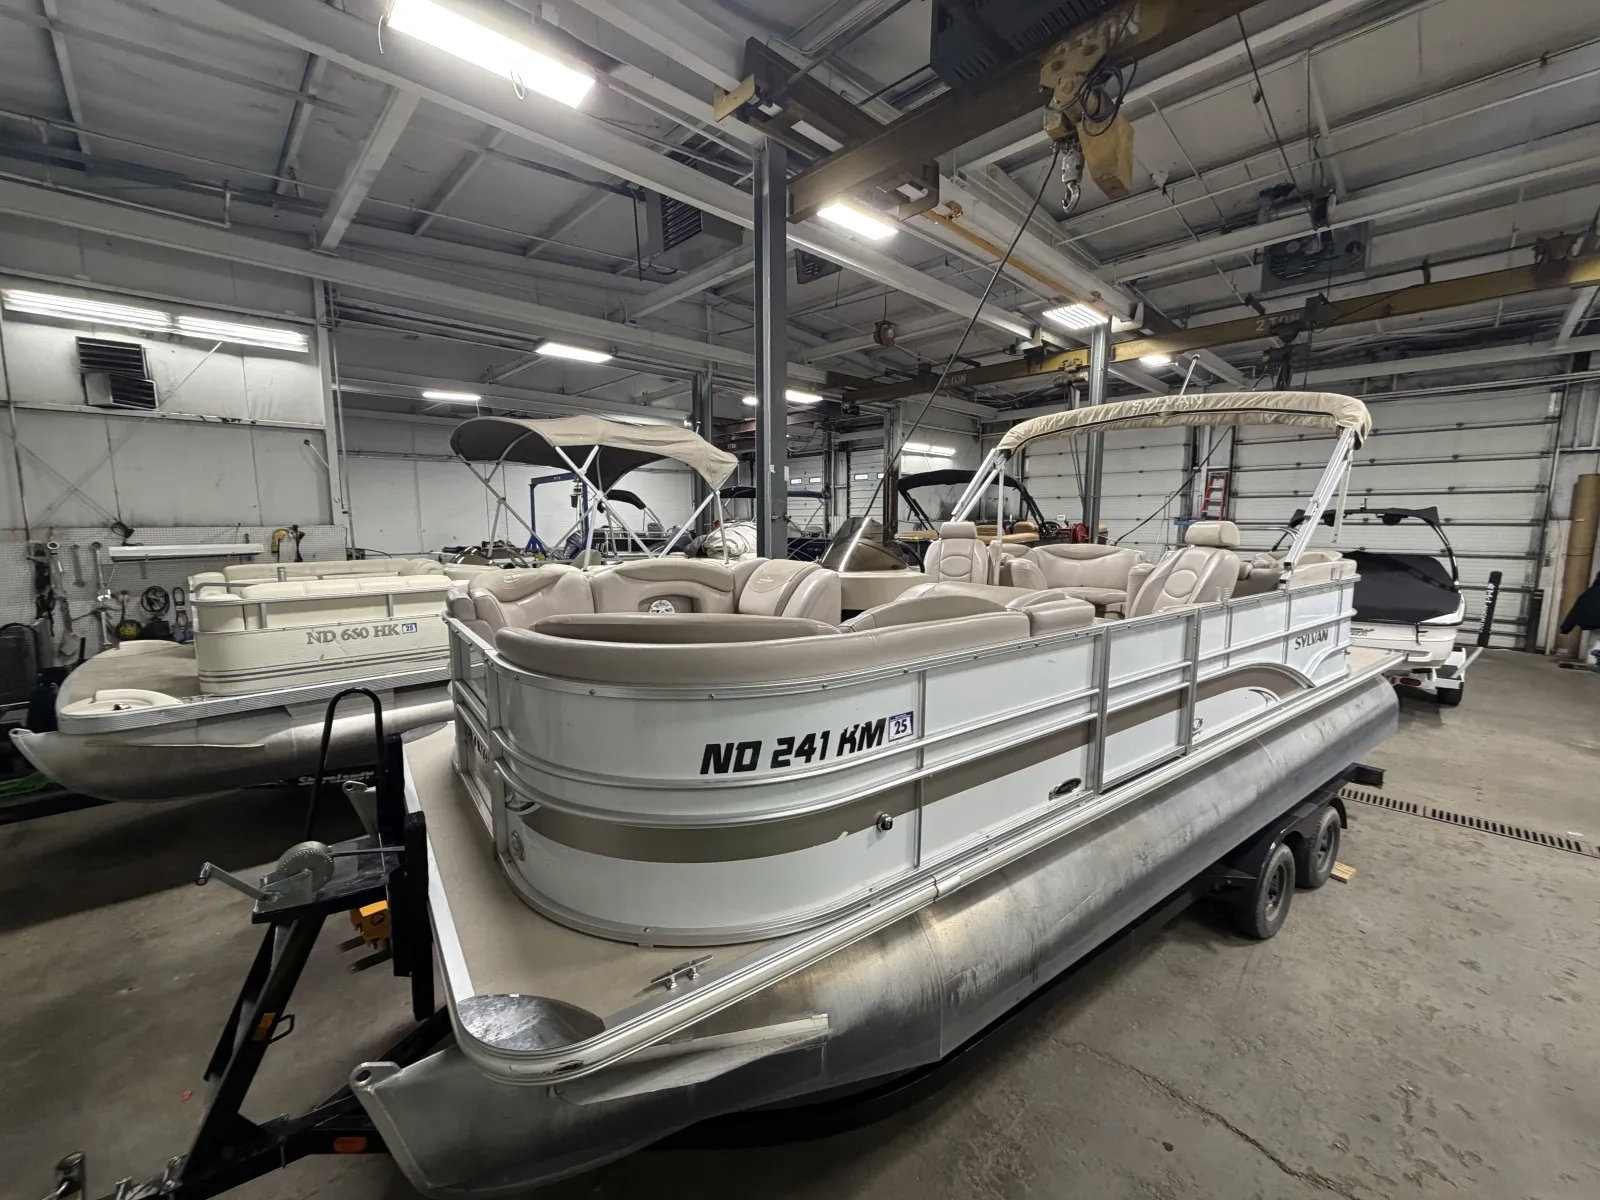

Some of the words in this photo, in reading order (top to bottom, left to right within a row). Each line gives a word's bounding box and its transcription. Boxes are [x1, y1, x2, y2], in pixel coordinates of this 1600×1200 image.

[1255, 319, 1265, 331] 2
[1131, 394, 1204, 416] SYLVAN
[305, 630, 337, 645] ND
[372, 624, 400, 637] HK
[1294, 629, 1329, 650] SYLVAN
[894, 718, 908, 735] 25
[699, 740, 762, 775] ND
[770, 730, 831, 769] 241
[836, 717, 887, 757] KM
